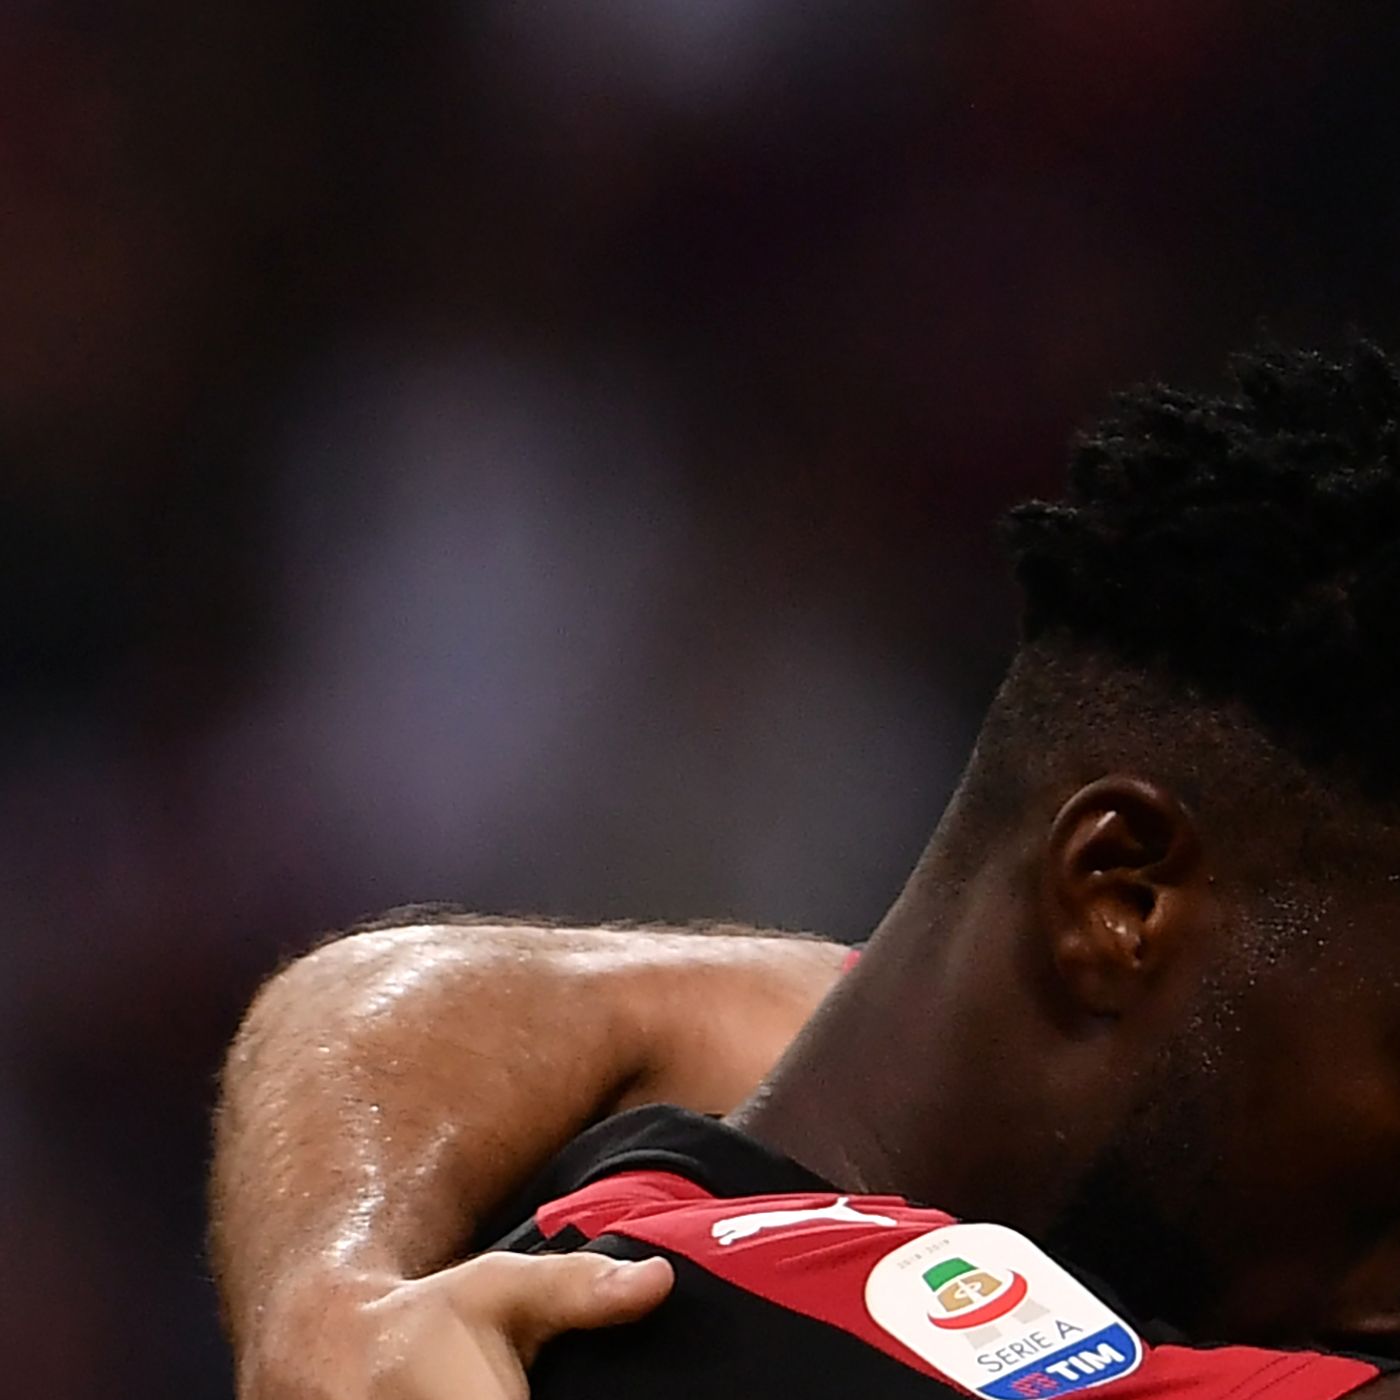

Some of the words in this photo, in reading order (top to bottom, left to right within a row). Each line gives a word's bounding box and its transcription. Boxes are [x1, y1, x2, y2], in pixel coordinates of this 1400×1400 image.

[976, 1331, 1053, 1373] SERIE
[1055, 1319, 1084, 1340] A
[1045, 1342, 1126, 1381] TIM
